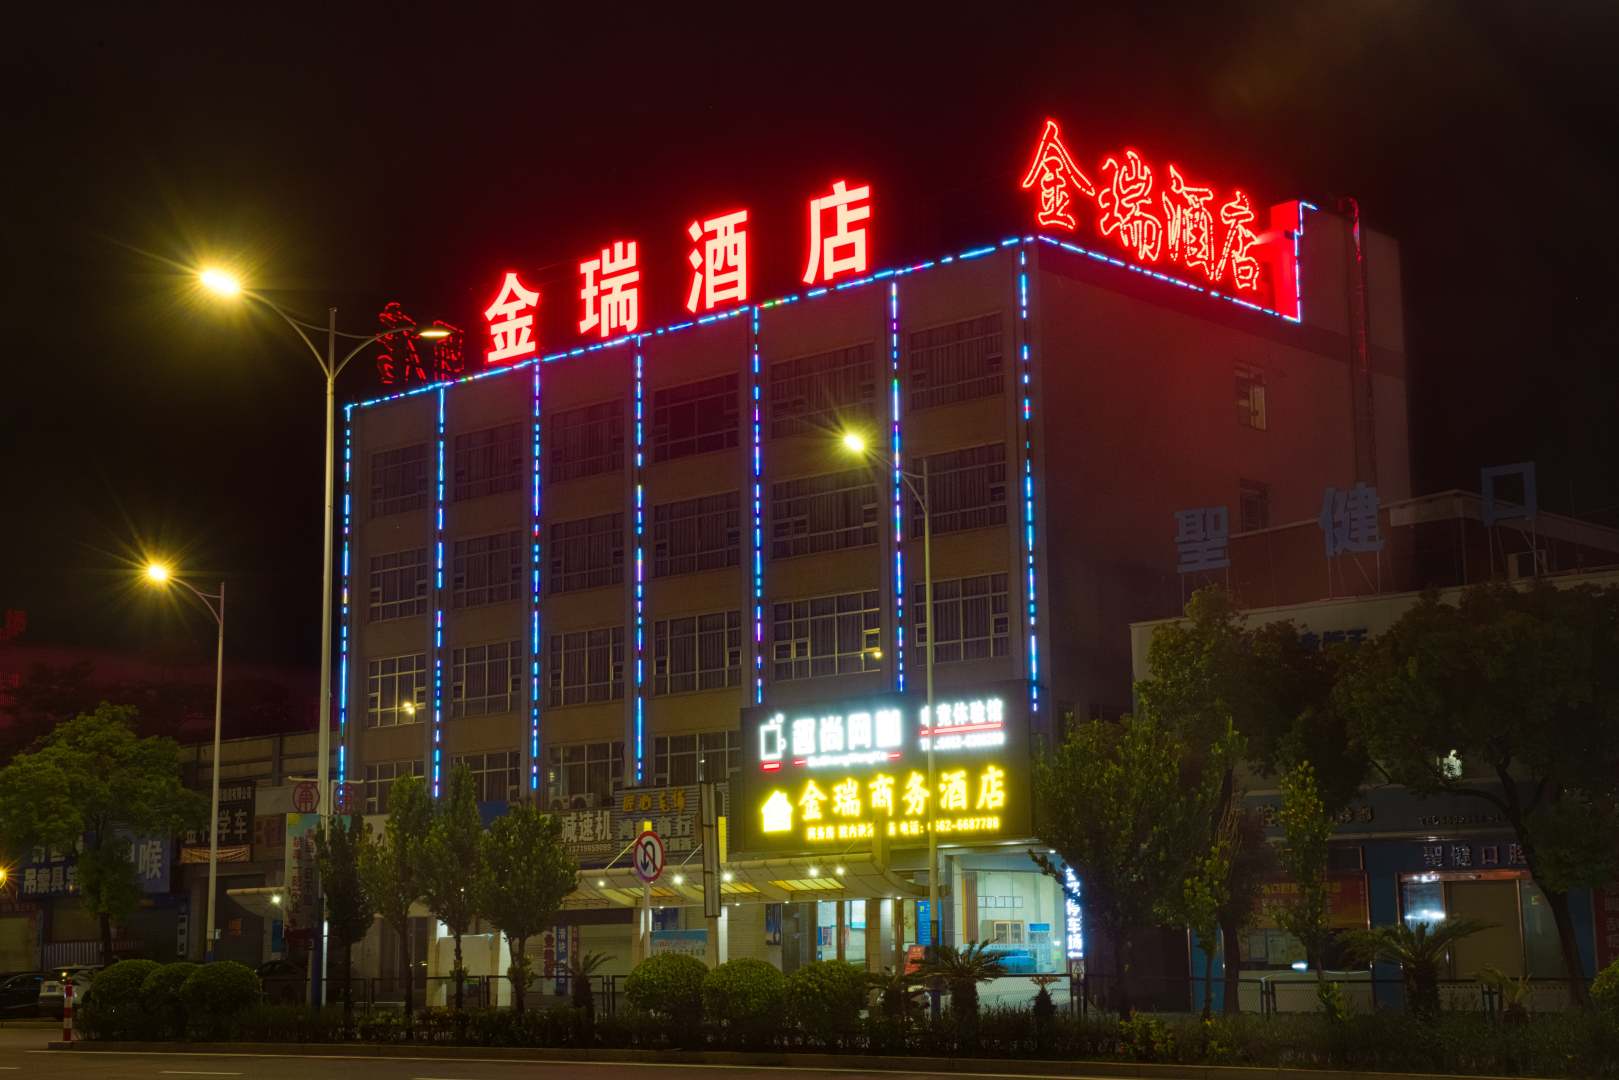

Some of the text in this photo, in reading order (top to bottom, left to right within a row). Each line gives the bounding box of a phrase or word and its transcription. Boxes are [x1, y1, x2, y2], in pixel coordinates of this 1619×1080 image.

[484, 180, 872, 365] 金瑞酒店
[1021, 119, 1260, 292] 金瑞酒店
[800, 766, 1005, 820] 金瑞商务酒店
